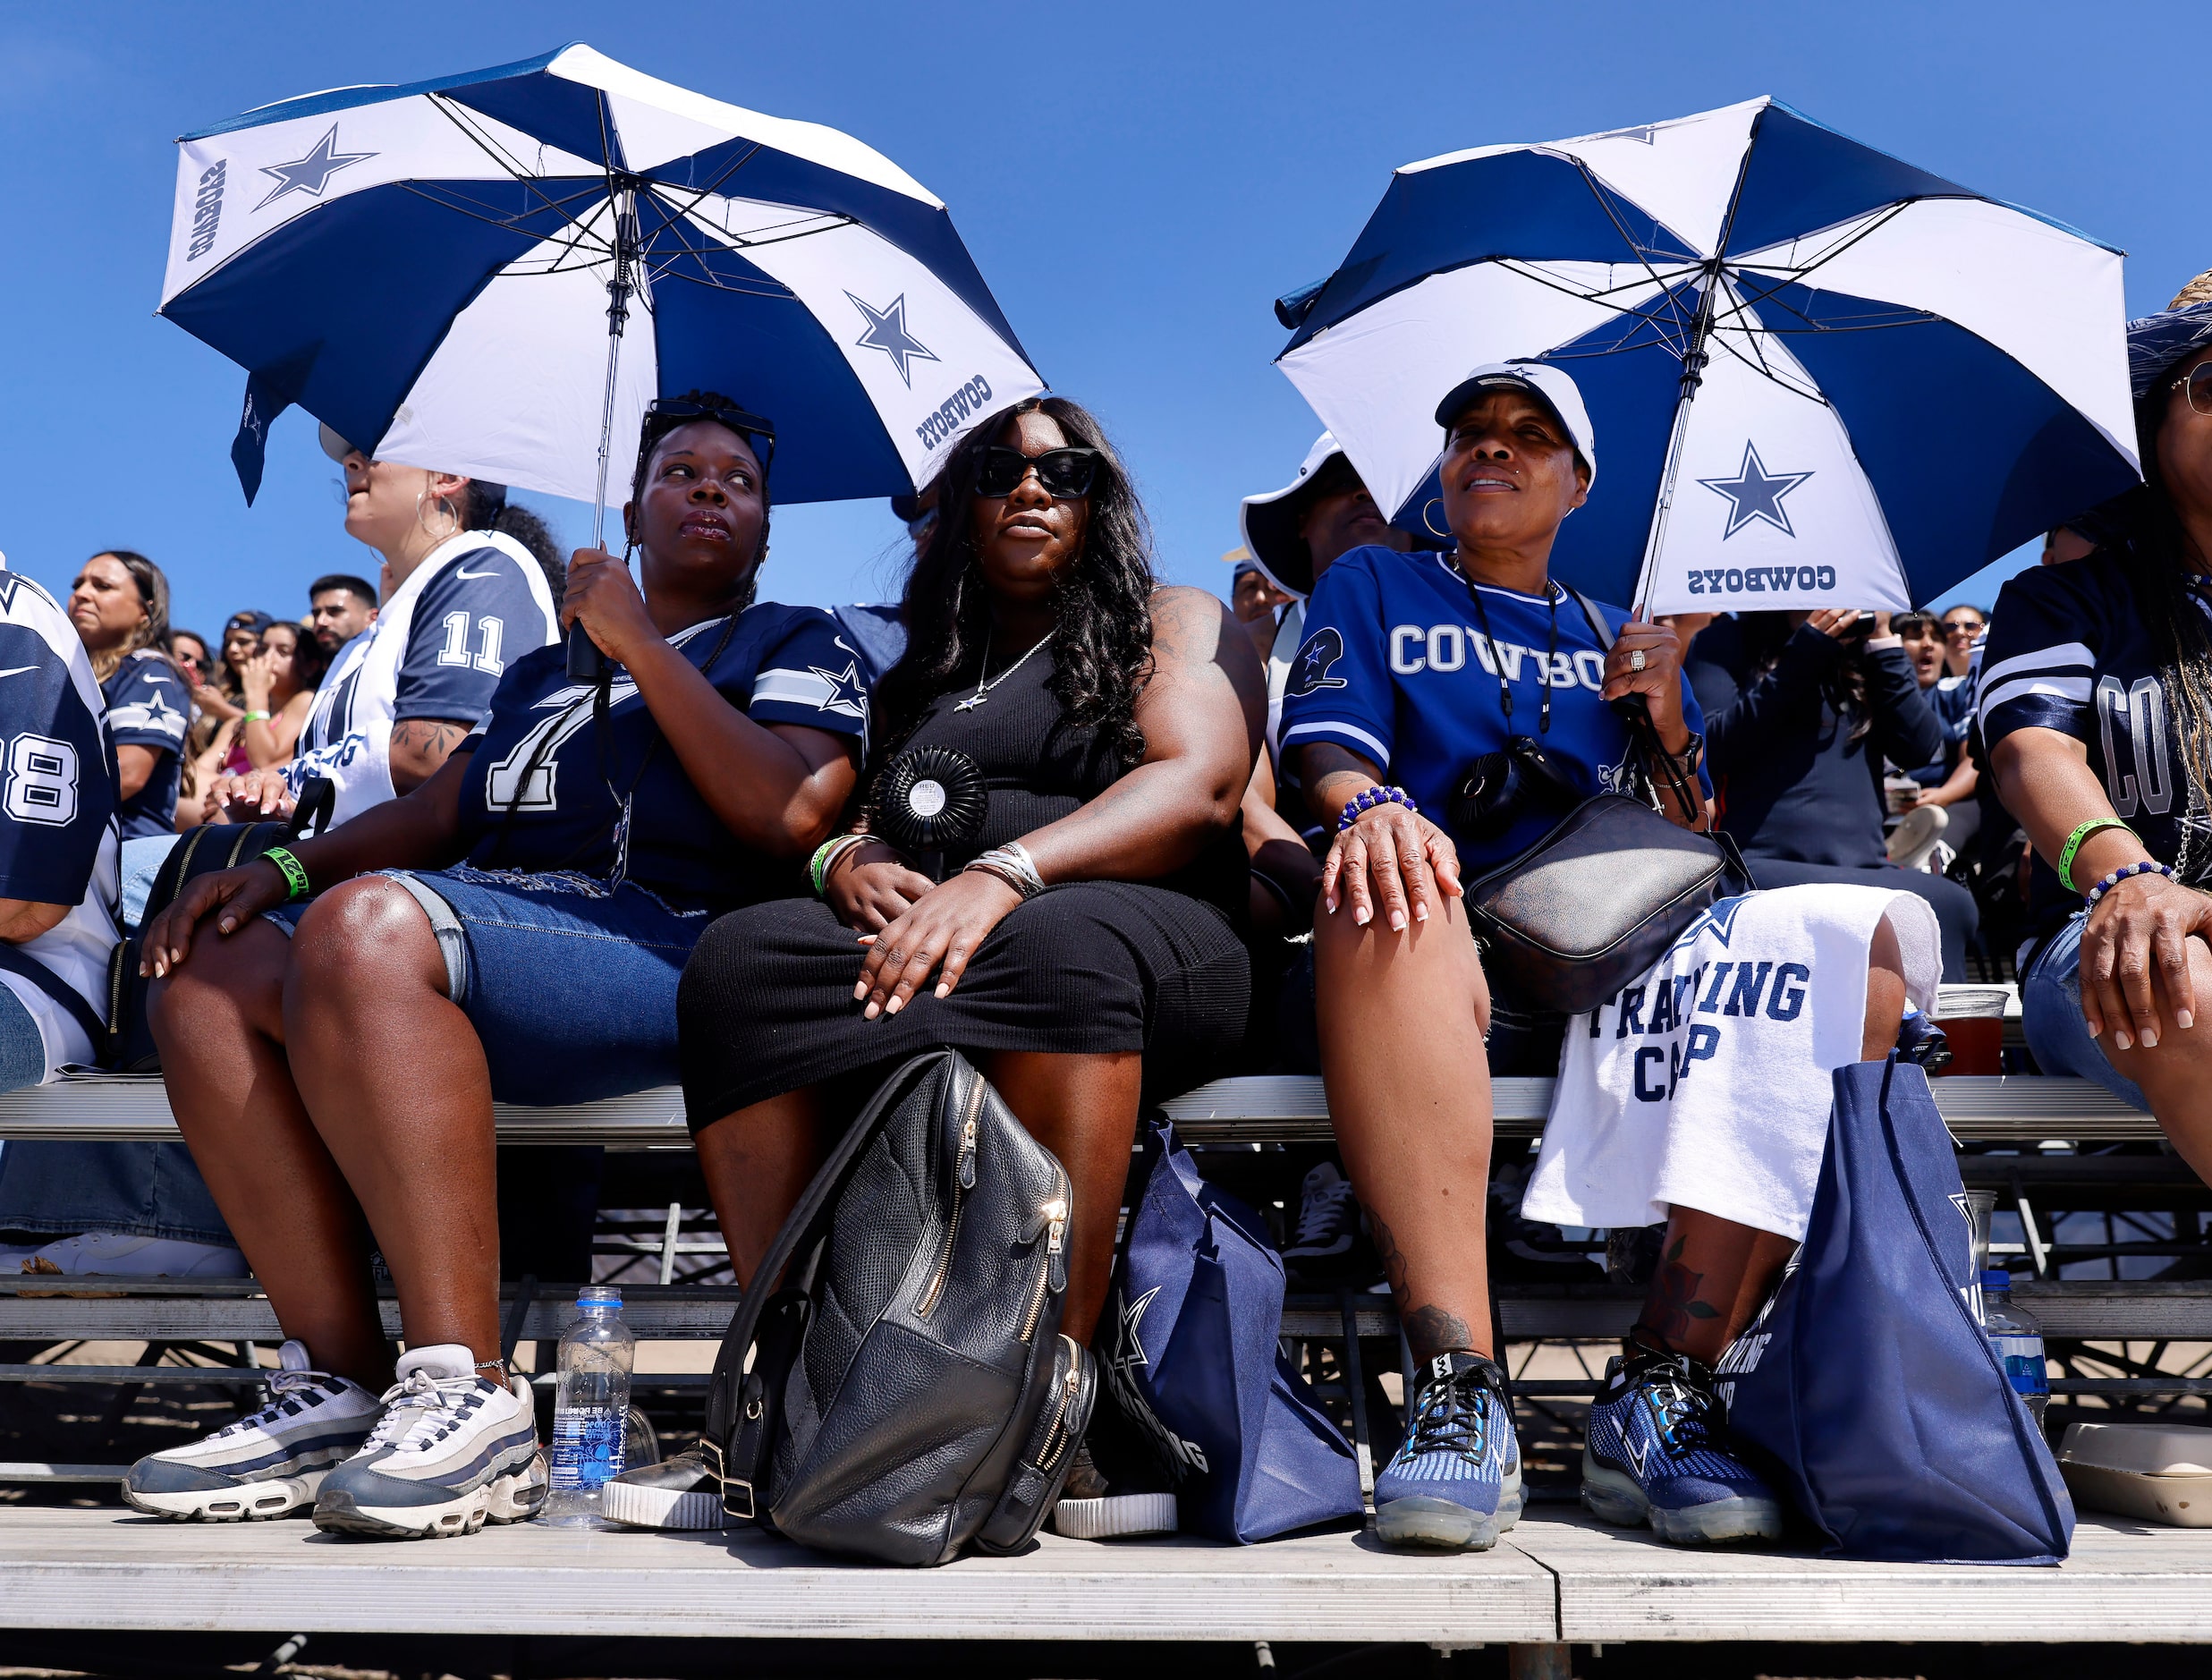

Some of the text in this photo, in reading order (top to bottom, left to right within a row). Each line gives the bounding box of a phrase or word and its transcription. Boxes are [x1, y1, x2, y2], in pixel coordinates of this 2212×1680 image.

[436, 610, 504, 677] 11
[0, 731, 80, 828] 8
[485, 683, 640, 811] 7
[275, 853, 302, 877] 21
